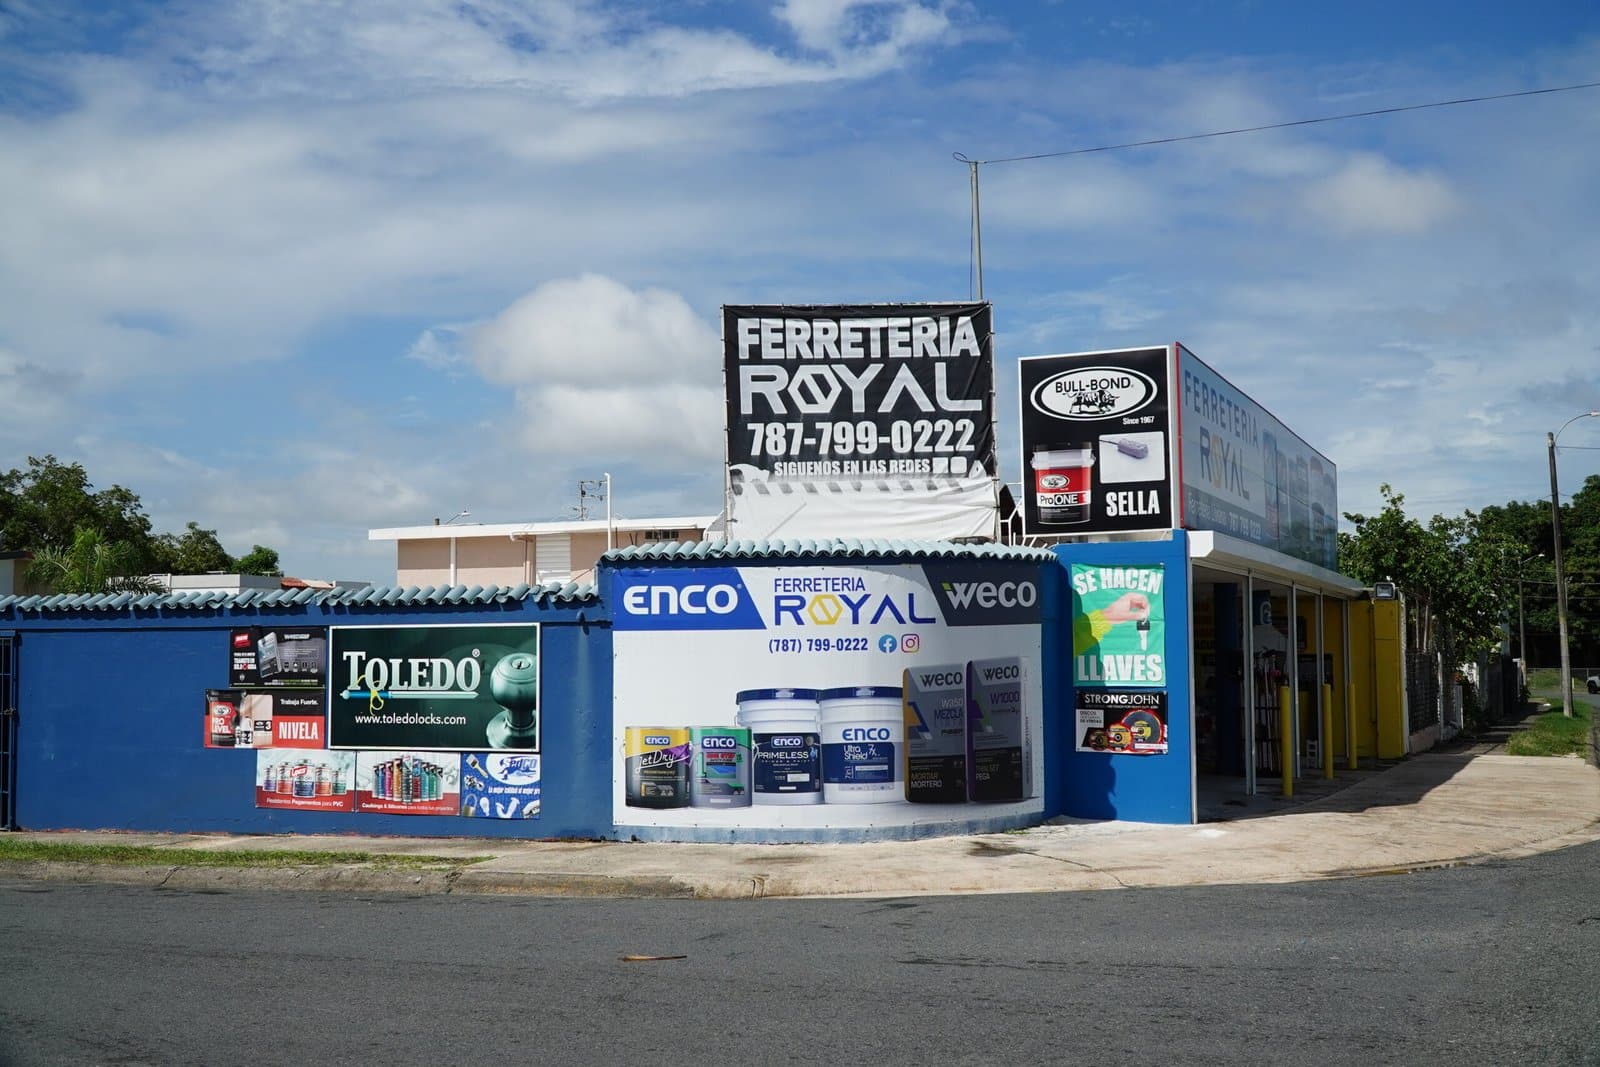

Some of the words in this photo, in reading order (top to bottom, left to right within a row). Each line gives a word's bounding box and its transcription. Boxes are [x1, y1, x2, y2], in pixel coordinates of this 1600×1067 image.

[738, 316, 981, 359] FERRETERIA
[739, 362, 982, 414] ROYAL
[1055, 377, 1131, 393] BULL-BOND
[1184, 369, 1259, 449] FERRETERIA
[1122, 417, 1139, 425] Since
[747, 419, 975, 456] 787-799-0222
[774, 460, 840, 477] SIGUENOS
[843, 460, 860, 476] EN
[862, 460, 887, 475] LAS
[889, 458, 930, 474] REDES
[1200, 426, 1250, 501] ROYAL
[1105, 489, 1160, 517] SELLA
[774, 577, 866, 593] FERRETERIA
[1072, 570, 1098, 595] SE
[1099, 567, 1163, 595] HACEN
[774, 593, 936, 626] ROYAL
[769, 638, 802, 654] (787)
[807, 637, 868, 651] 799-0222
[343, 651, 481, 692] TOLEDO
[1077, 654, 1163, 682] LLAVES
[280, 698, 300, 706] Trabaja
[1084, 694, 1160, 705] STRONGJOHN
[355, 712, 467, 725] www.toledolocks.com
[278, 721, 319, 740] NIVELA
[757, 751, 809, 759] PRIMELESS
[844, 751, 868, 760] Shield
